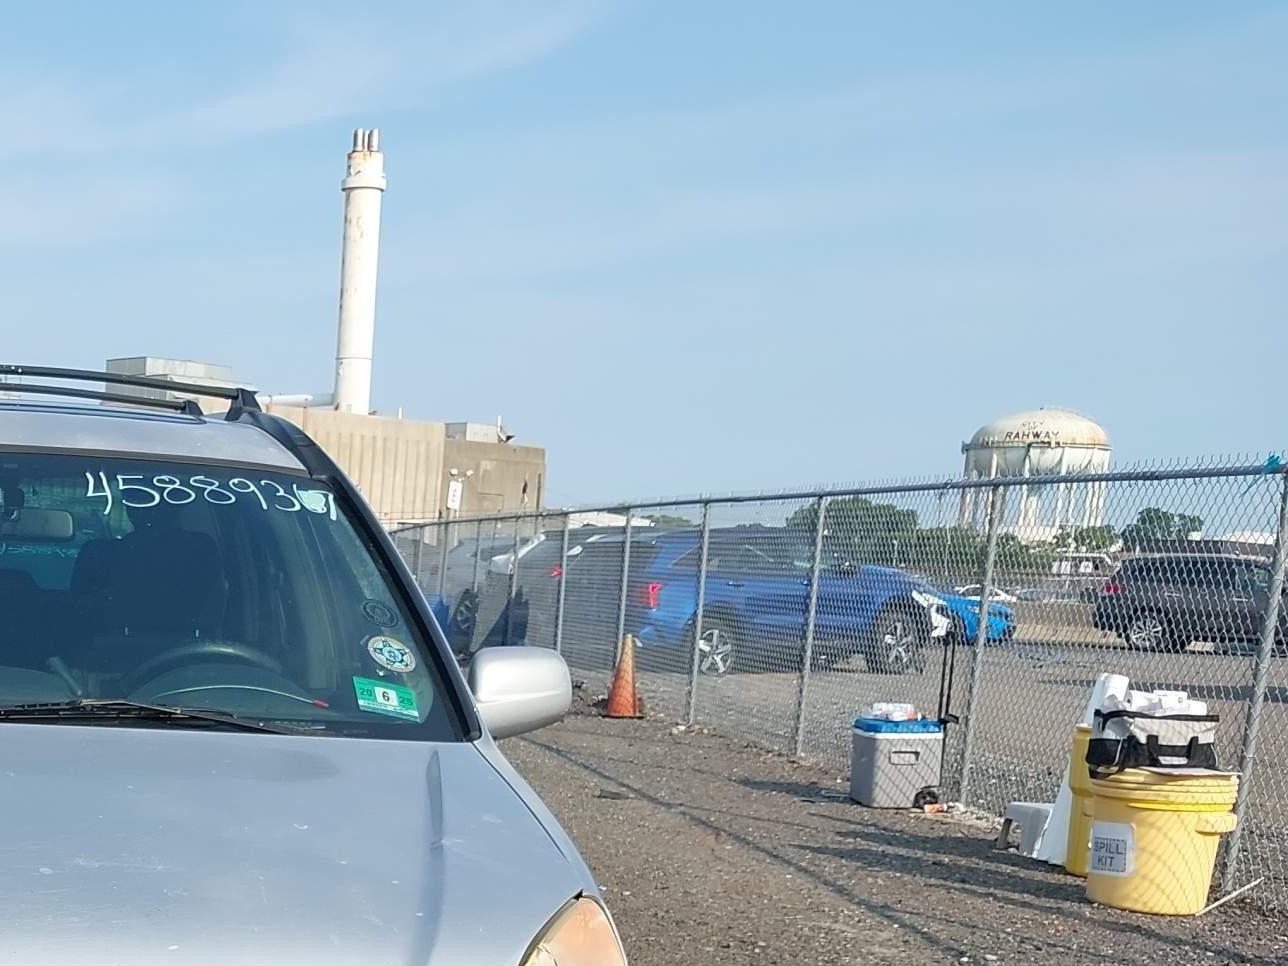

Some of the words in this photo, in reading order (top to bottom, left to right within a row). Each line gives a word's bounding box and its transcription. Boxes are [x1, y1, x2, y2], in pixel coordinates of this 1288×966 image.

[1004, 430, 1060, 441] RAHWAY
[382, 690, 391, 702] 6
[1094, 840, 1124, 855] SPILL
[1097, 855, 1116, 868] KIT
